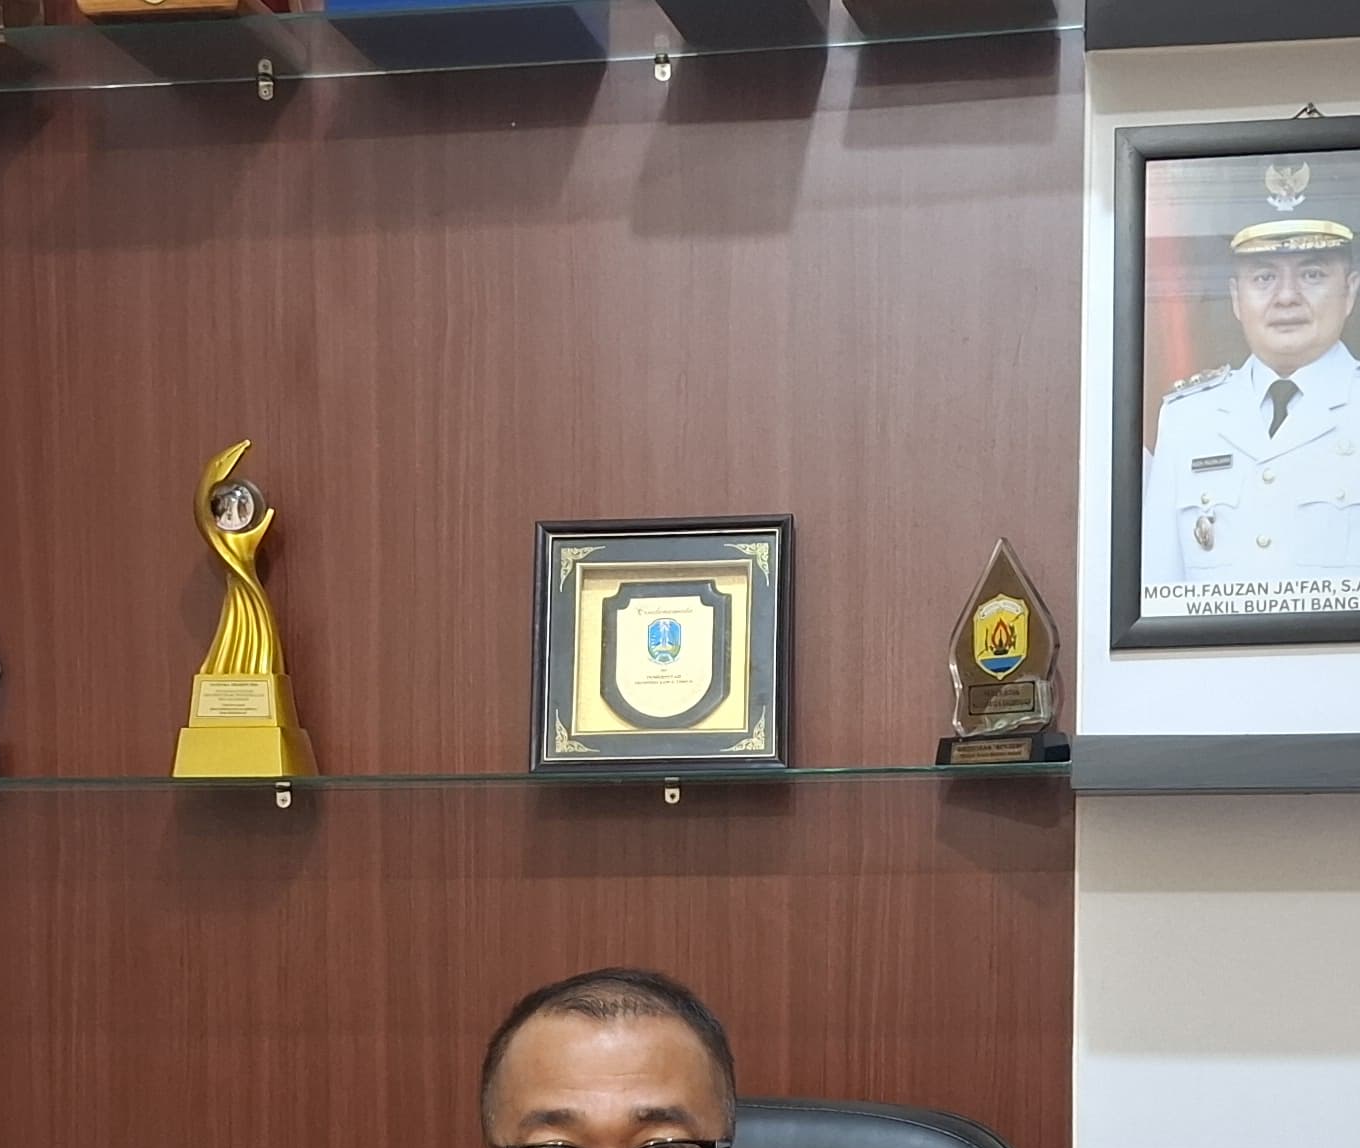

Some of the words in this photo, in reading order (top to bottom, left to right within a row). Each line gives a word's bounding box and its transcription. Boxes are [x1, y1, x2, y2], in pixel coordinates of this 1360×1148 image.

[1273, 580, 1337, 596] JA'FAR,
[1186, 600, 1239, 615] WAKIL
[1244, 598, 1305, 613] BUPATI
